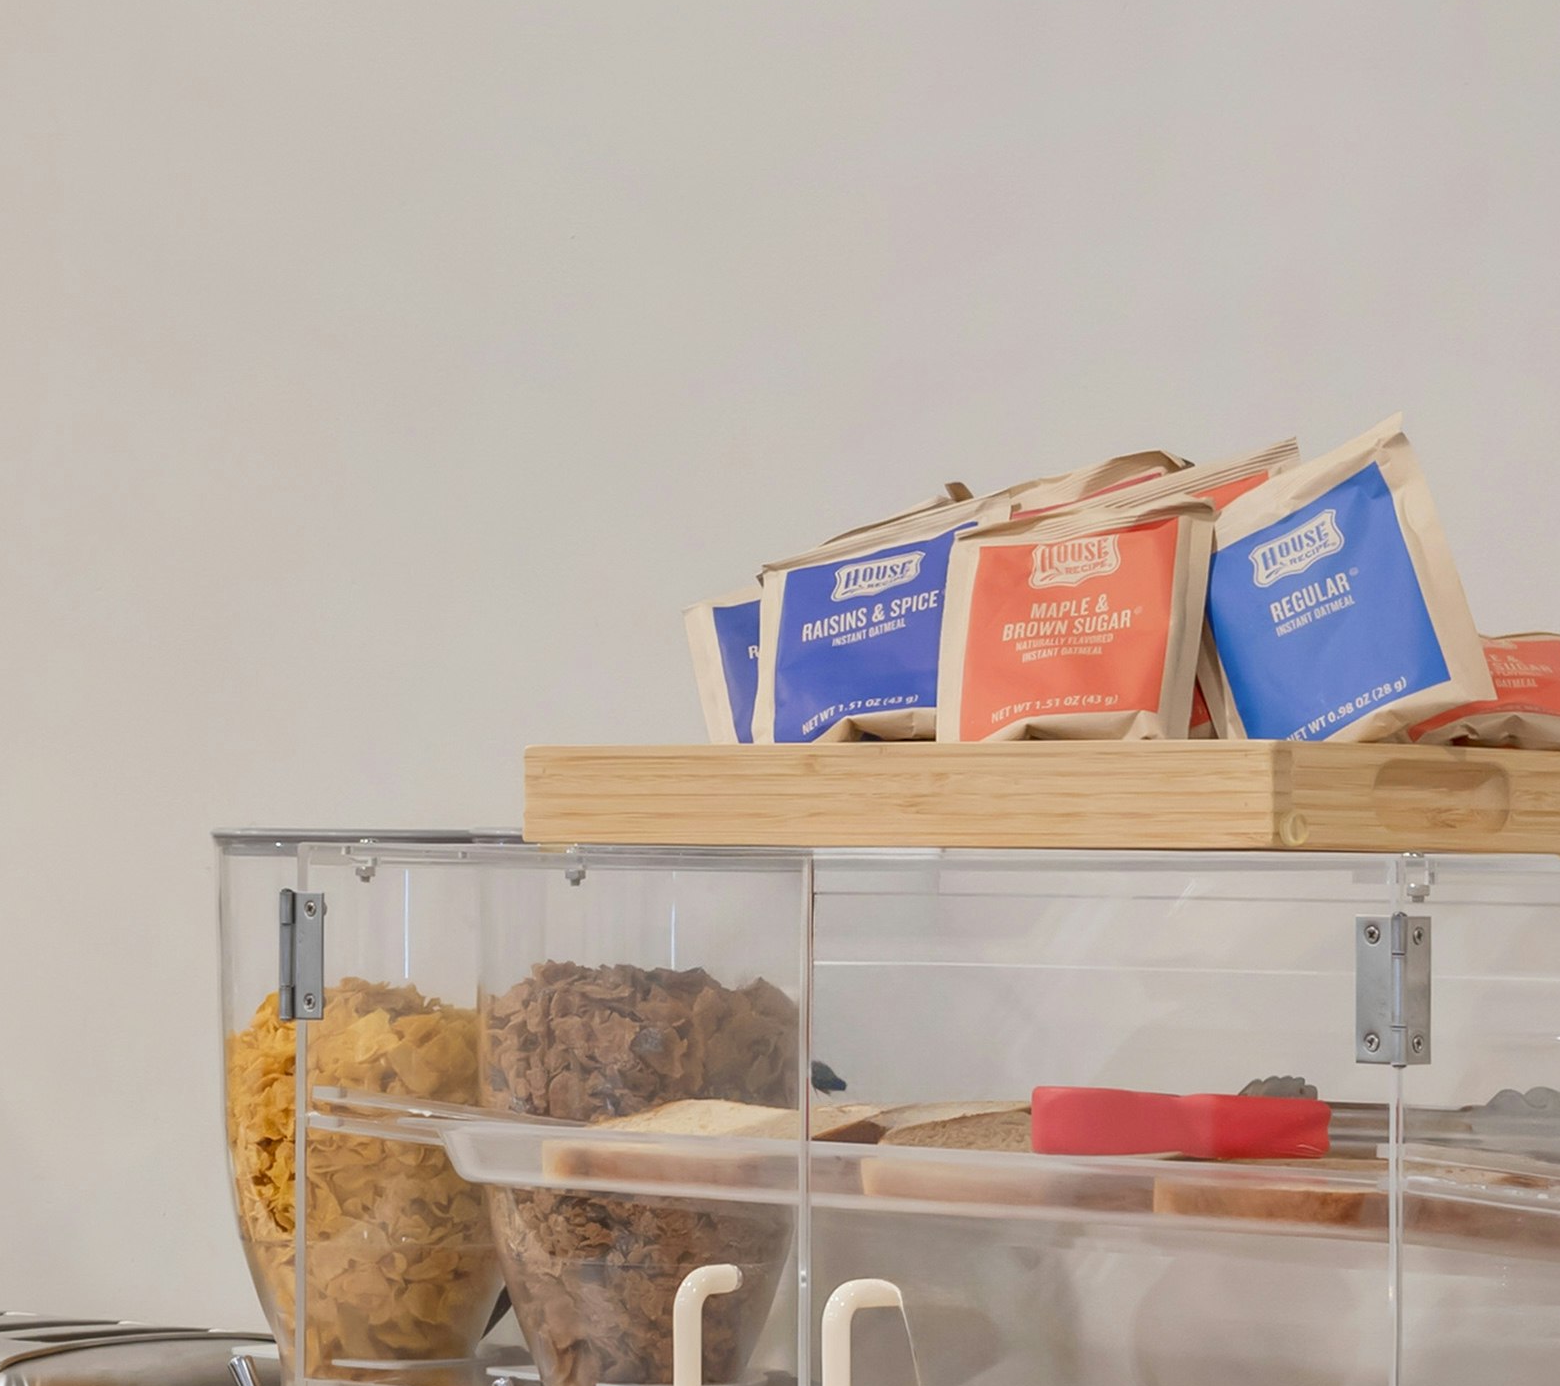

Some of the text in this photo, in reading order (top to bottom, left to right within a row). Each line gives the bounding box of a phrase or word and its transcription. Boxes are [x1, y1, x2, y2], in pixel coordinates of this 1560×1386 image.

[1260, 520, 1330, 572] HOUSE
[1288, 539, 1331, 567] RECIPE
[844, 559, 914, 590] HOUSE
[1064, 560, 1110, 576] RECIPE
[1030, 593, 1109, 619] MAPLE &
[1269, 571, 1351, 624] REGULAR
[801, 589, 940, 642] RAISINS & SPICE
[1002, 609, 1131, 642] BROWN SUGAR
[1275, 594, 1356, 638] INSTANT OATMEAL
[831, 617, 906, 647] INSTANT OATMEAL
[1015, 636, 1065, 652] NATURALLY
[1021, 645, 1103, 664] INSTANT OATMEAL
[801, 694, 919, 735] NET WT 1.51 OZ (43 g)
[991, 708, 1012, 724] NET
[1013, 701, 1031, 714] WT
[1035, 699, 1061, 710] 1.51
[1063, 696, 1081, 707] OZ
[1082, 695, 1103, 706] (43
[1307, 715, 1327, 734] WT
[1327, 701, 1355, 724] 0.98
[1355, 692, 1372, 709] OZ
[1371, 681, 1392, 702] (28
[1393, 676, 1407, 693] g)
